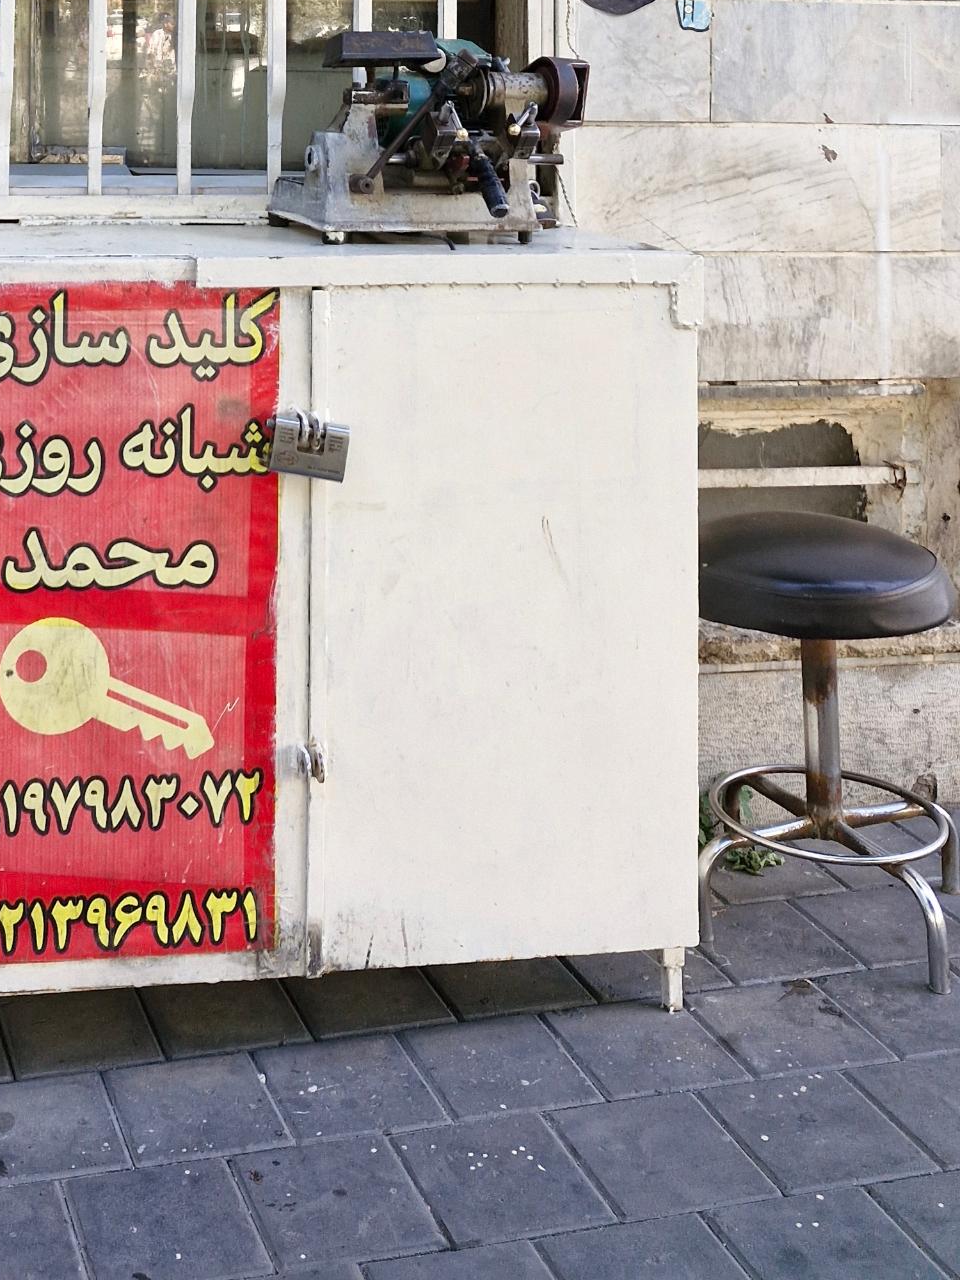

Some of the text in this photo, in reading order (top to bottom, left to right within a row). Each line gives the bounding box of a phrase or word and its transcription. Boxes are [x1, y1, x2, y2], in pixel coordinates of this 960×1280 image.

[146, 287, 279, 381] کلید
[120, 404, 271, 493] شبانه
[2, 527, 218, 593] محمد
